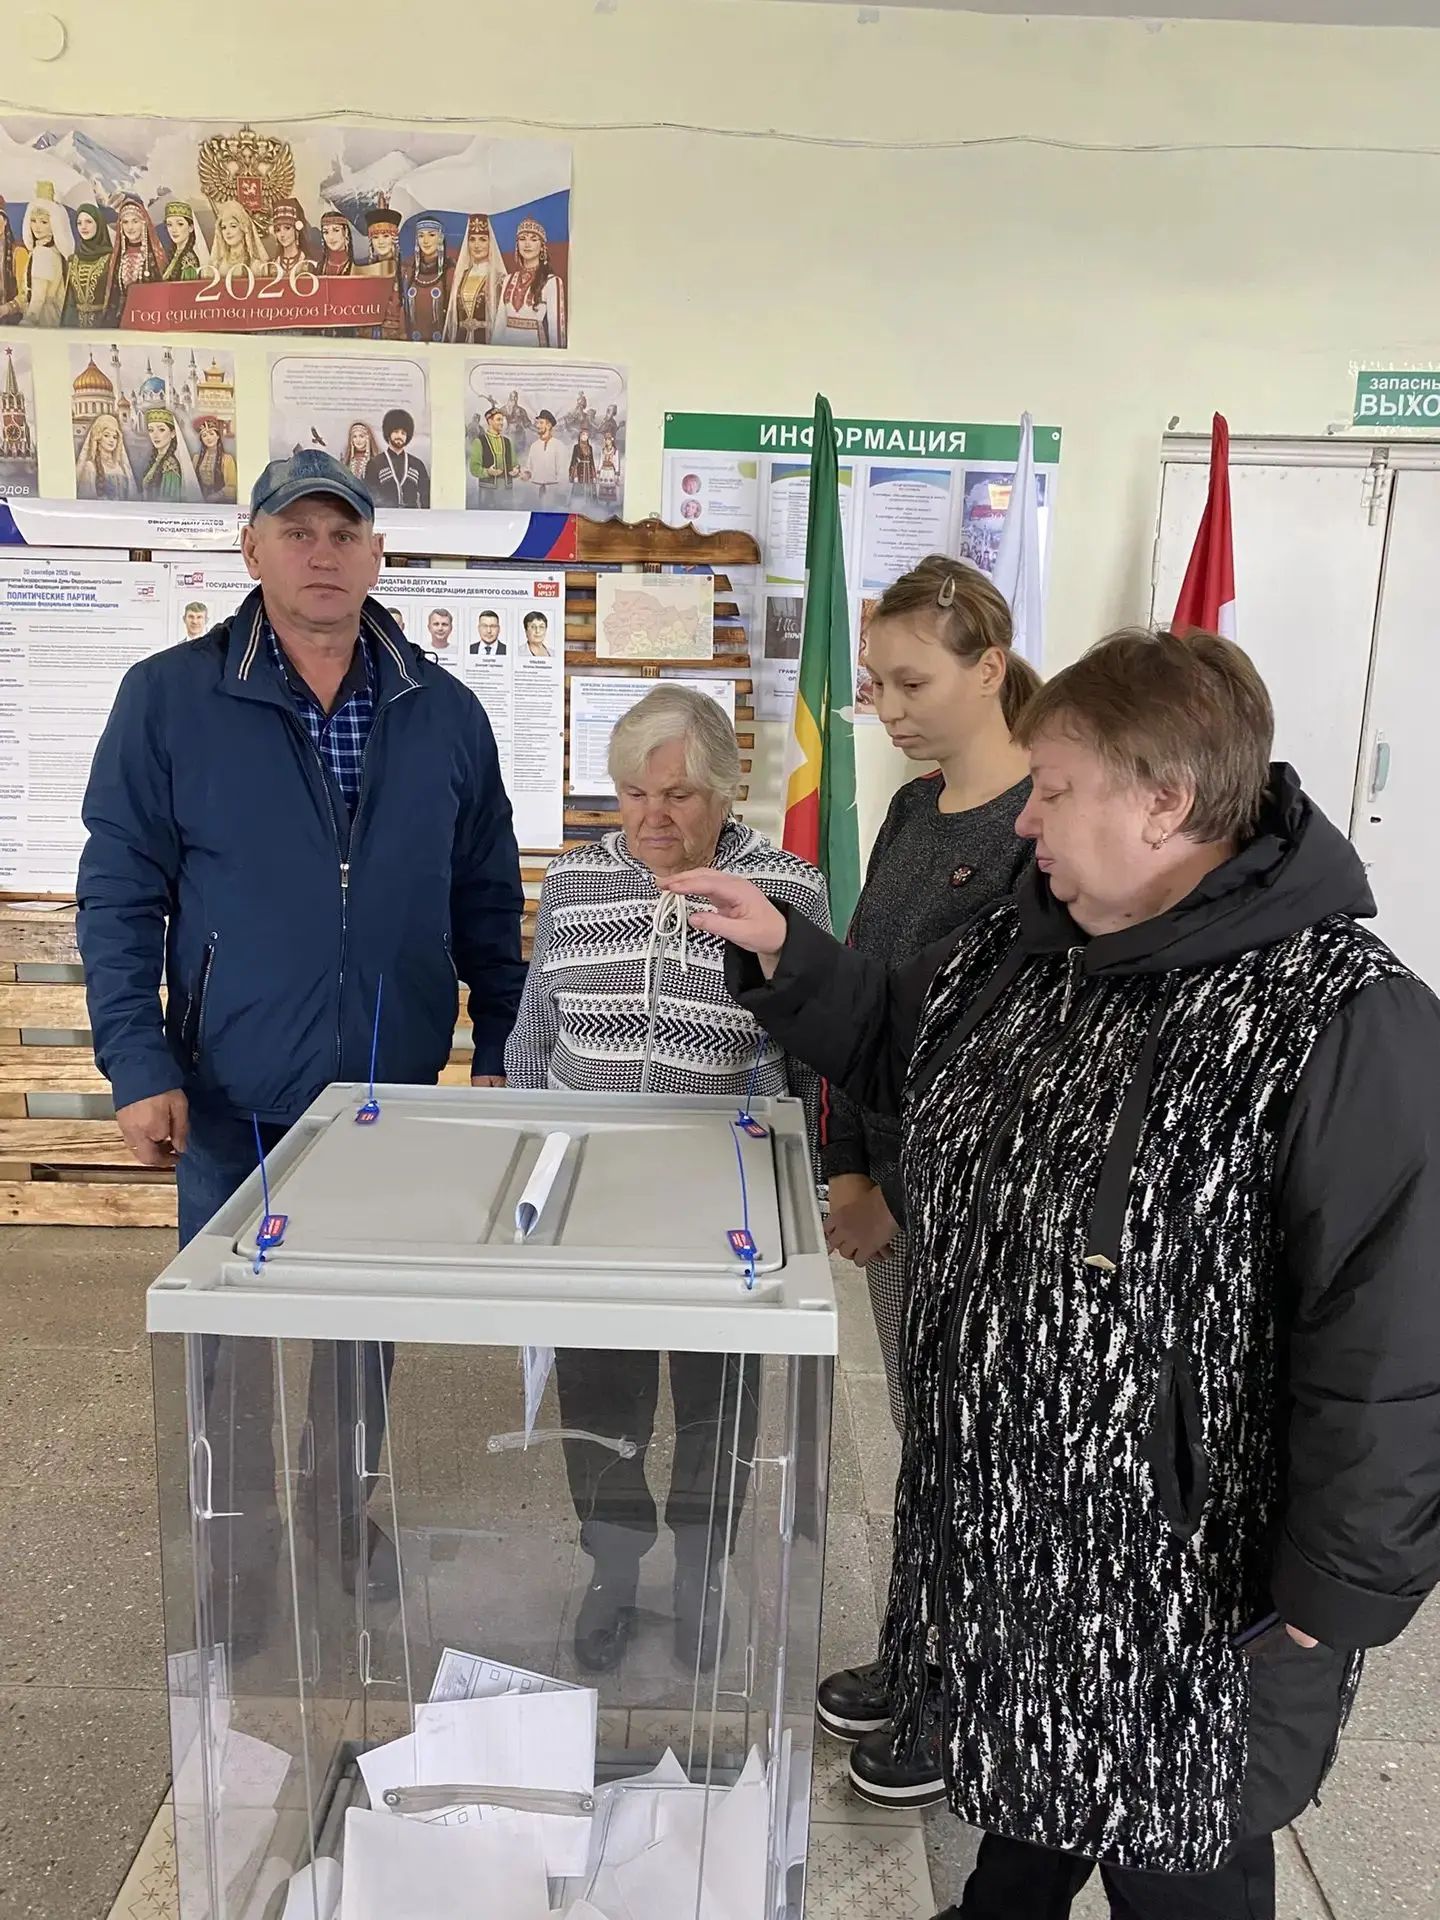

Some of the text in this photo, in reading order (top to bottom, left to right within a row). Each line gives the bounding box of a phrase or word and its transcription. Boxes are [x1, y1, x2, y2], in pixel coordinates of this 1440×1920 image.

[195, 260, 319, 302] 2026
[131, 303, 381, 324] Год единства народов России
[7, 591, 65, 601] ПОЛИТИЧЕСКИЕ
[426, 586, 466, 595] ФЕДЕРАЦИИ
